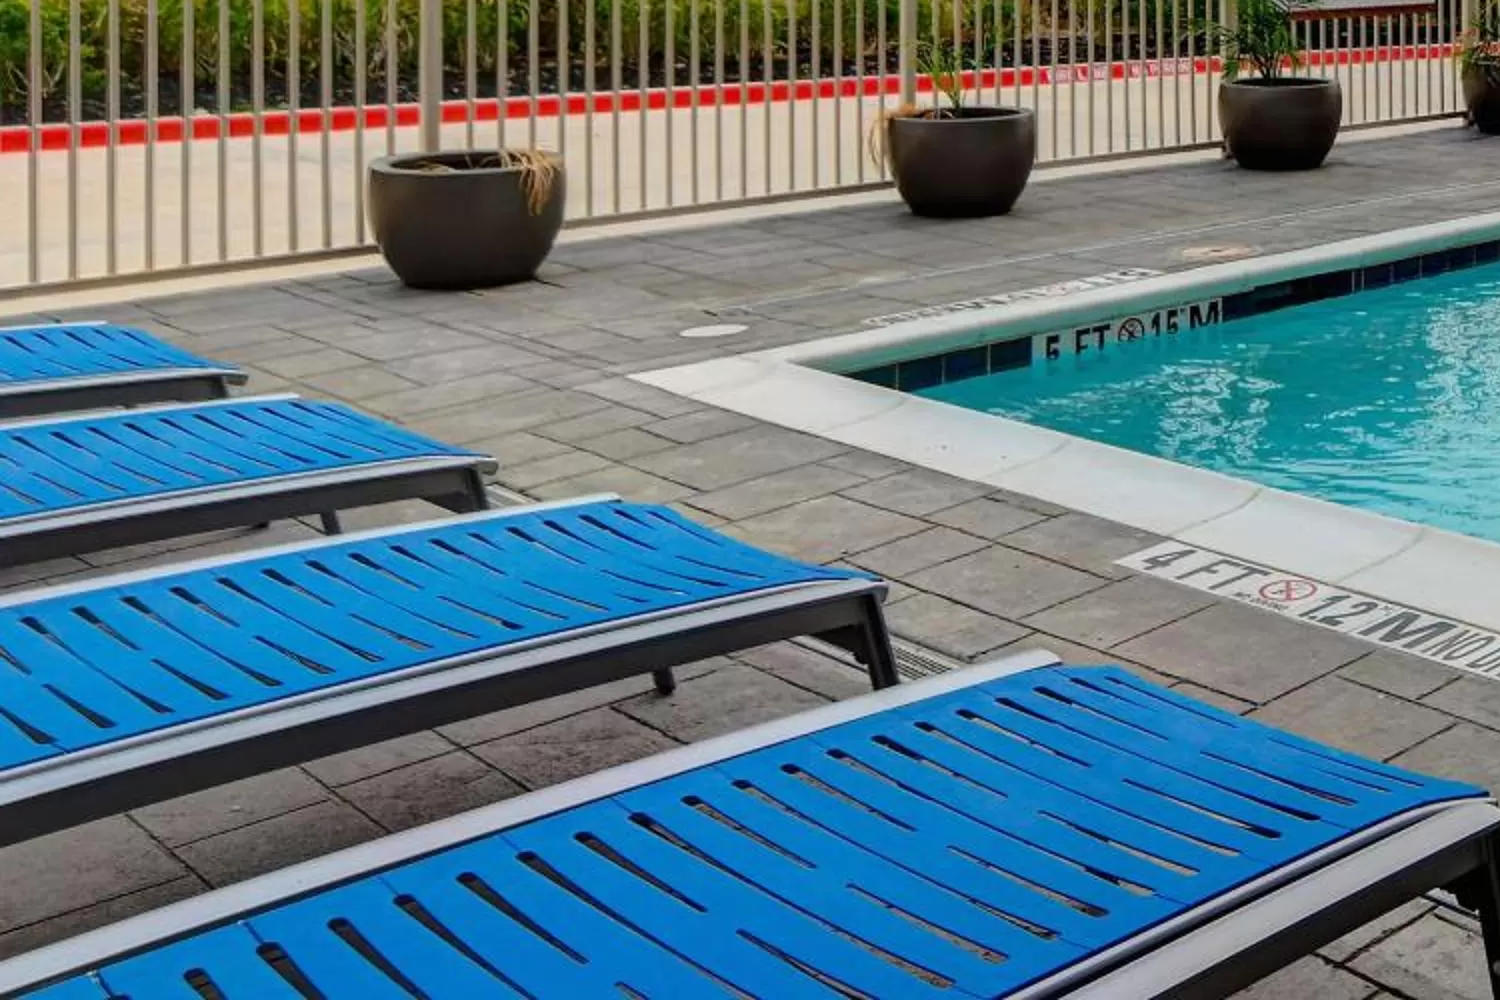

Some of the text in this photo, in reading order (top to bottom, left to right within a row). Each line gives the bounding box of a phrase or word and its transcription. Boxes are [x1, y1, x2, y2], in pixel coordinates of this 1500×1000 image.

[1045, 334, 1061, 361] 5
[1075, 323, 1111, 356] FT
[1189, 300, 1219, 330] M
[1142, 549, 1198, 570] 4
[1175, 558, 1273, 590] FT
[1298, 595, 1379, 626] 1.2
[1356, 611, 1459, 649] M
[1421, 629, 1496, 661] NO
